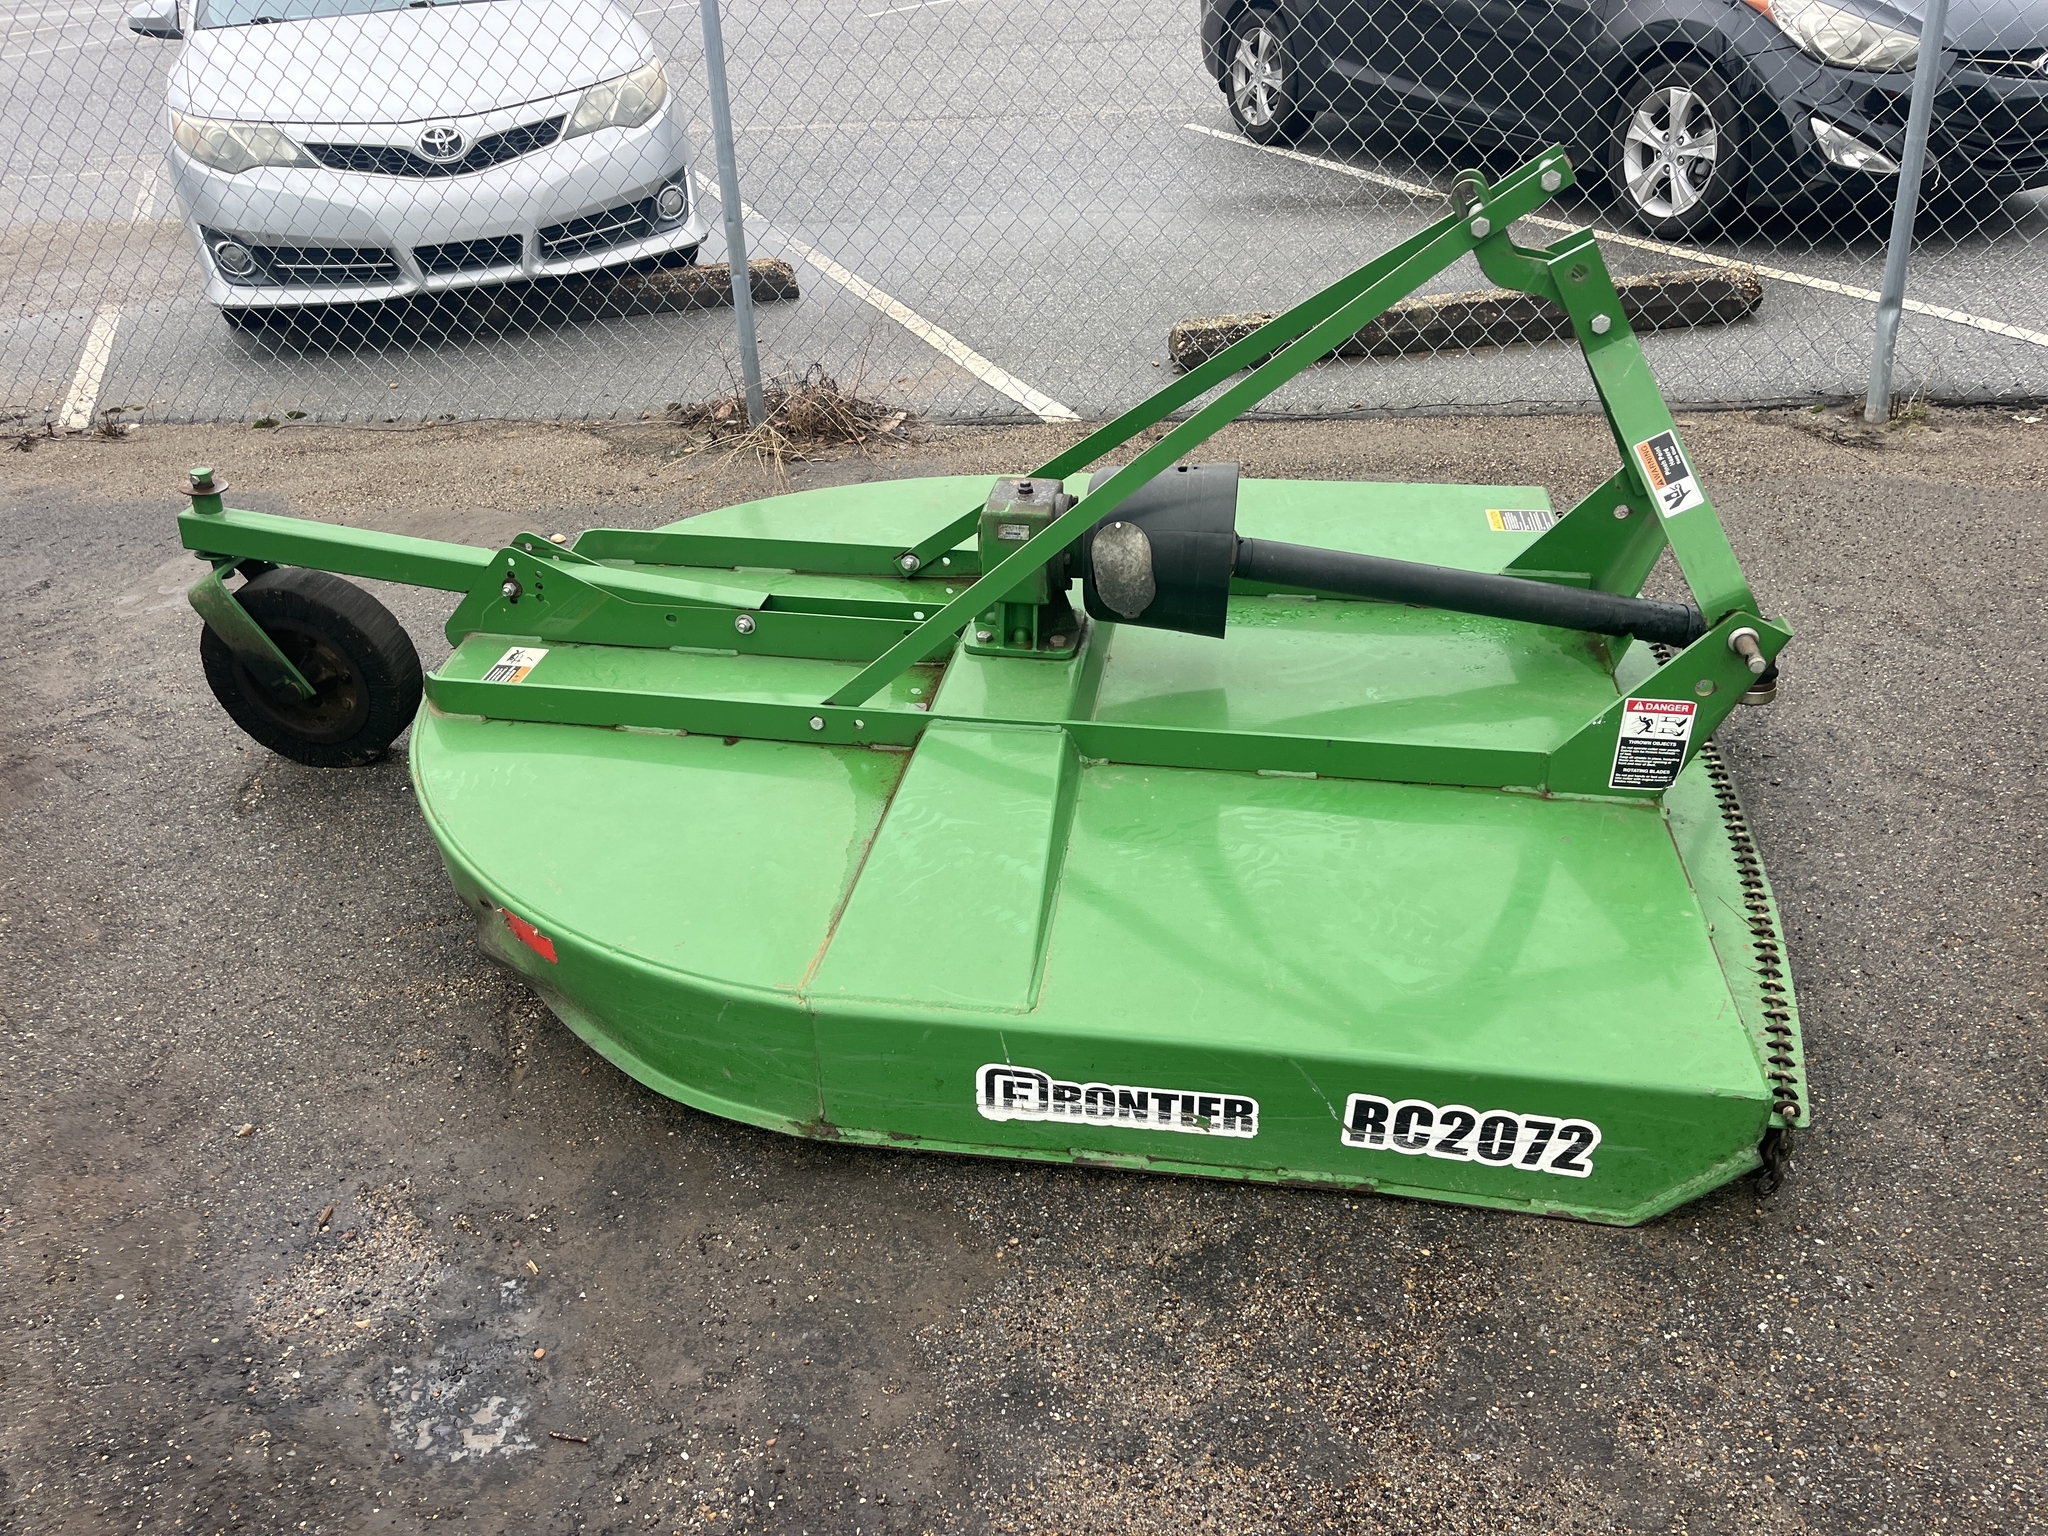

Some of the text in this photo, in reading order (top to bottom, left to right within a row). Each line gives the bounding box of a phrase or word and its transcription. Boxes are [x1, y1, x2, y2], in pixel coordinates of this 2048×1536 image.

[1641, 445, 1662, 480] WARNING
[1654, 446, 1664, 460] Point
[1645, 703, 1689, 712] DANGER
[985, 1068, 1254, 1133] FRONTIER
[1349, 1099, 1594, 1172] RC2072
